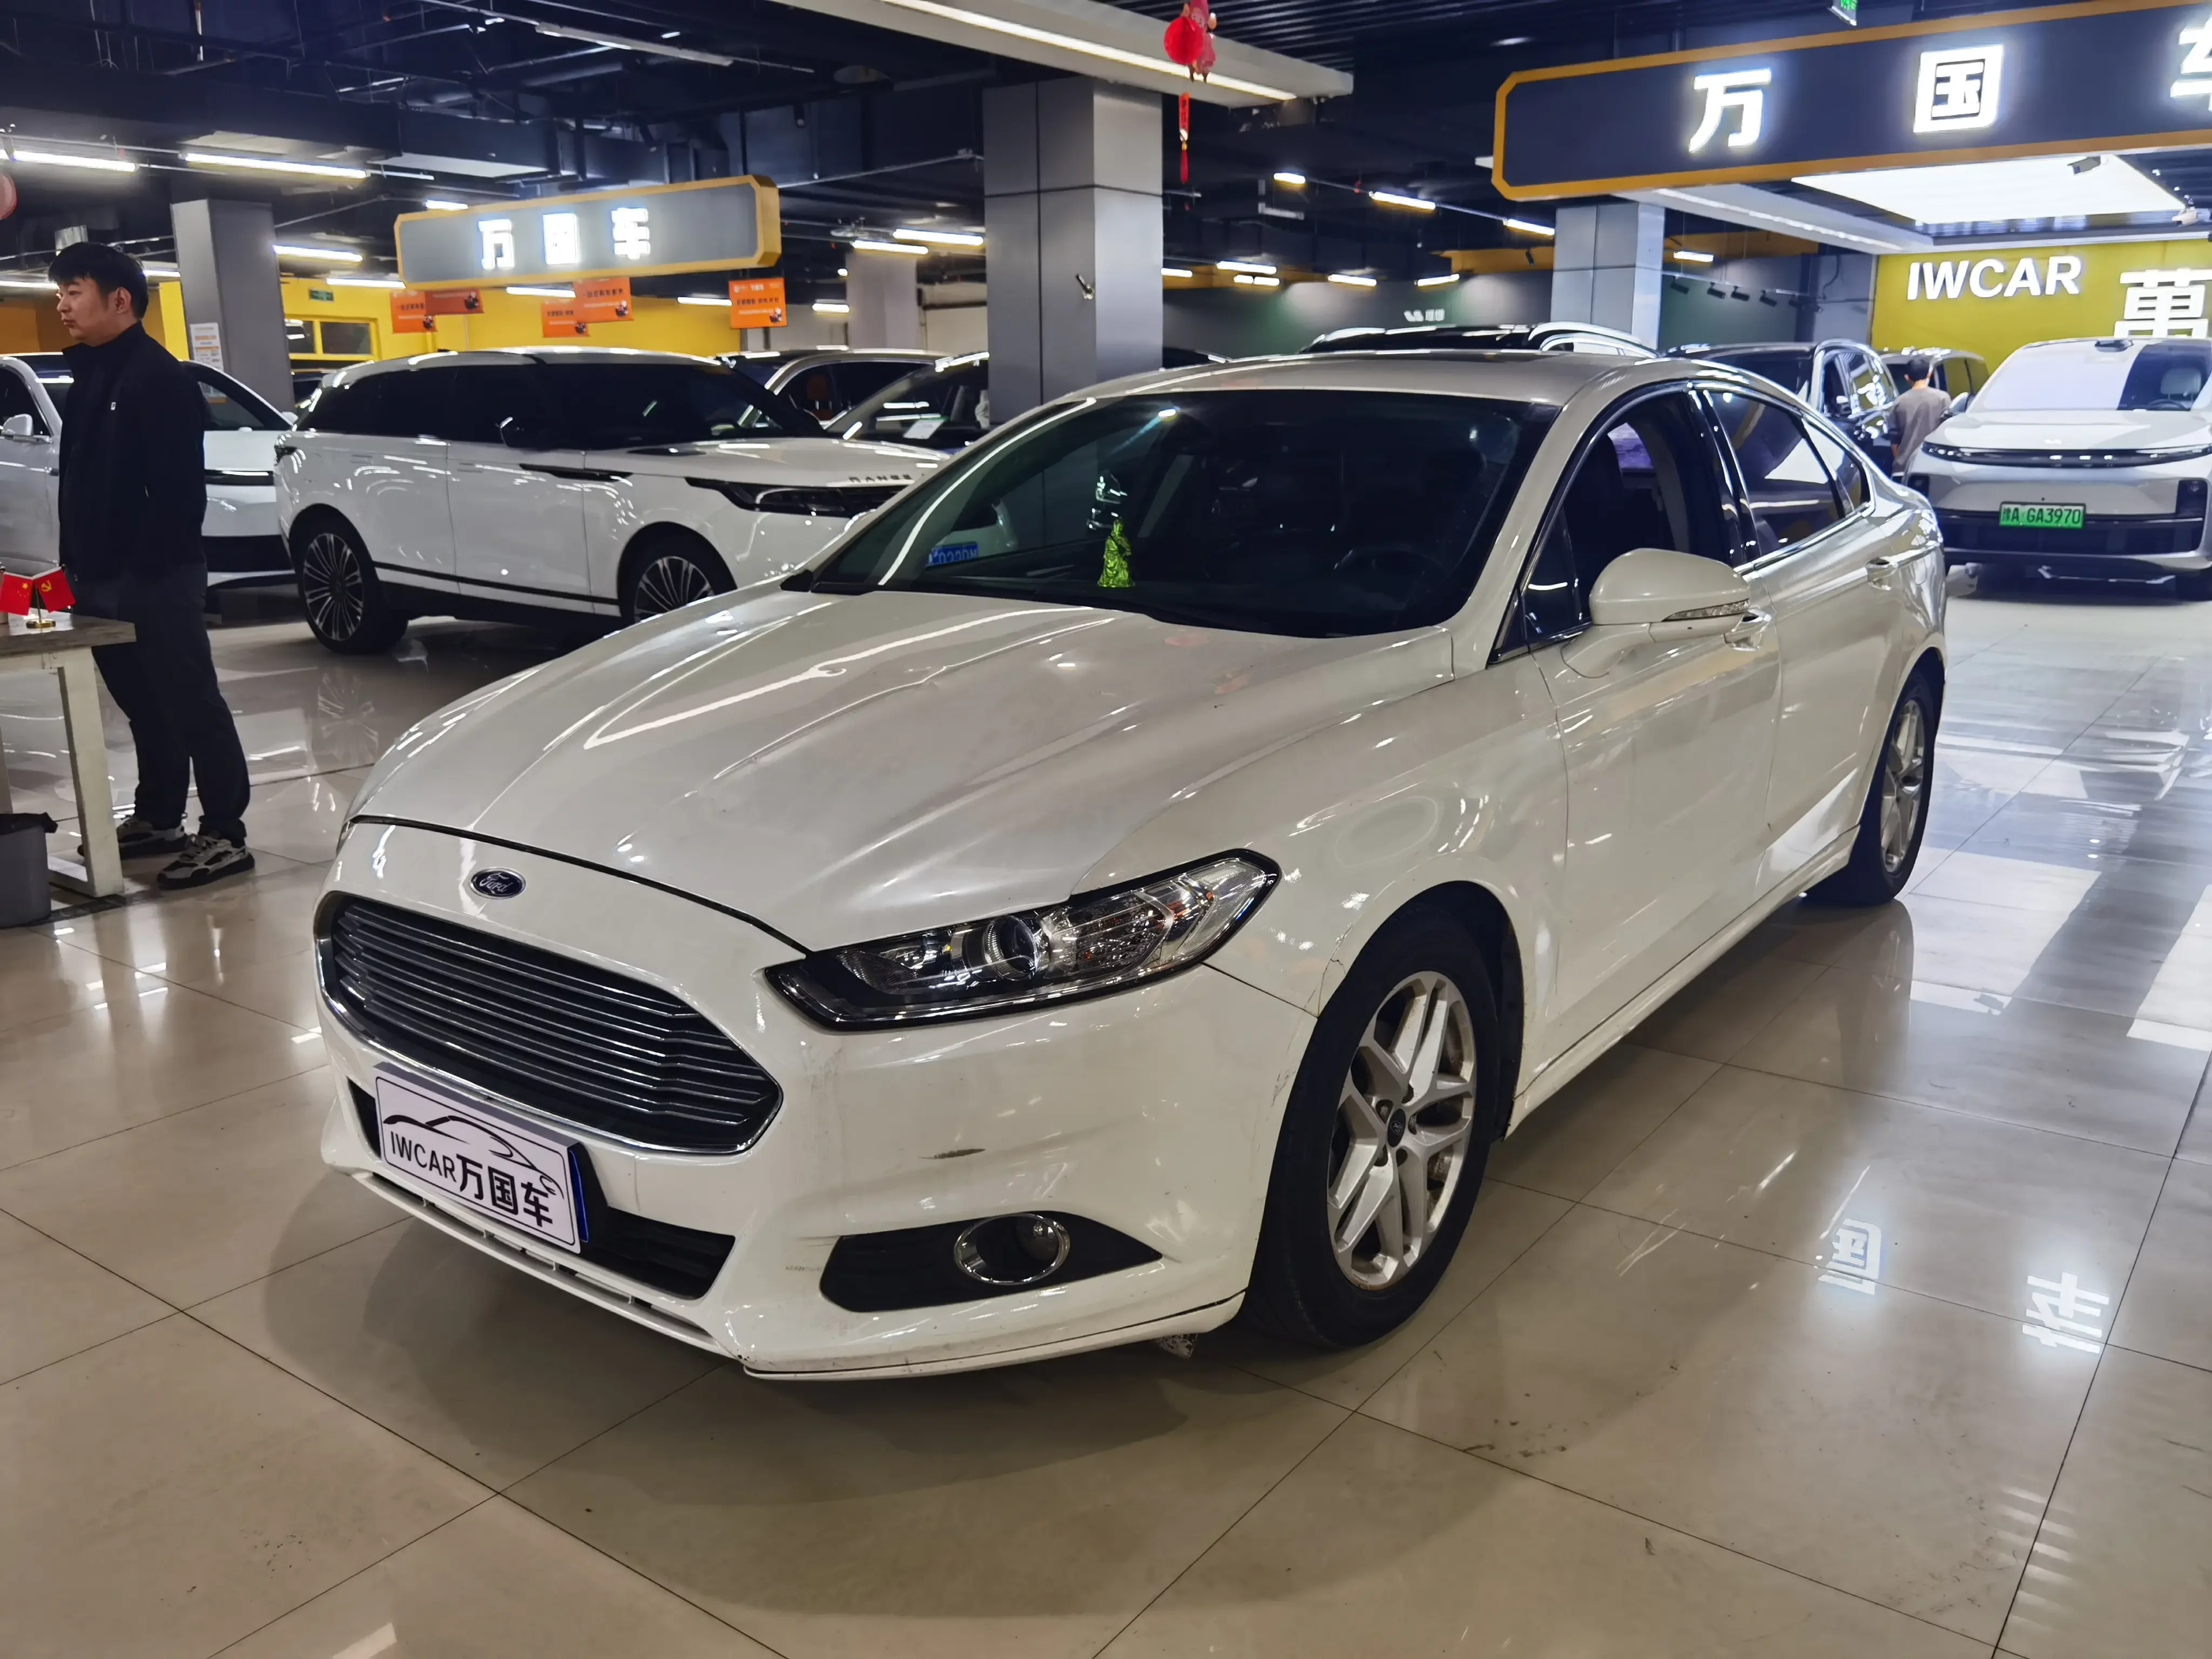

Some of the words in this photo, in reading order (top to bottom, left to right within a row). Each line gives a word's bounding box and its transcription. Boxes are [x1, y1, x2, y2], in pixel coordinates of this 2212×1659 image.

[1907, 255, 2081, 300] IWCAR
[848, 474, 913, 483] RANGE
[2026, 508, 2081, 524] GA3970
[479, 872, 514, 894] Ford
